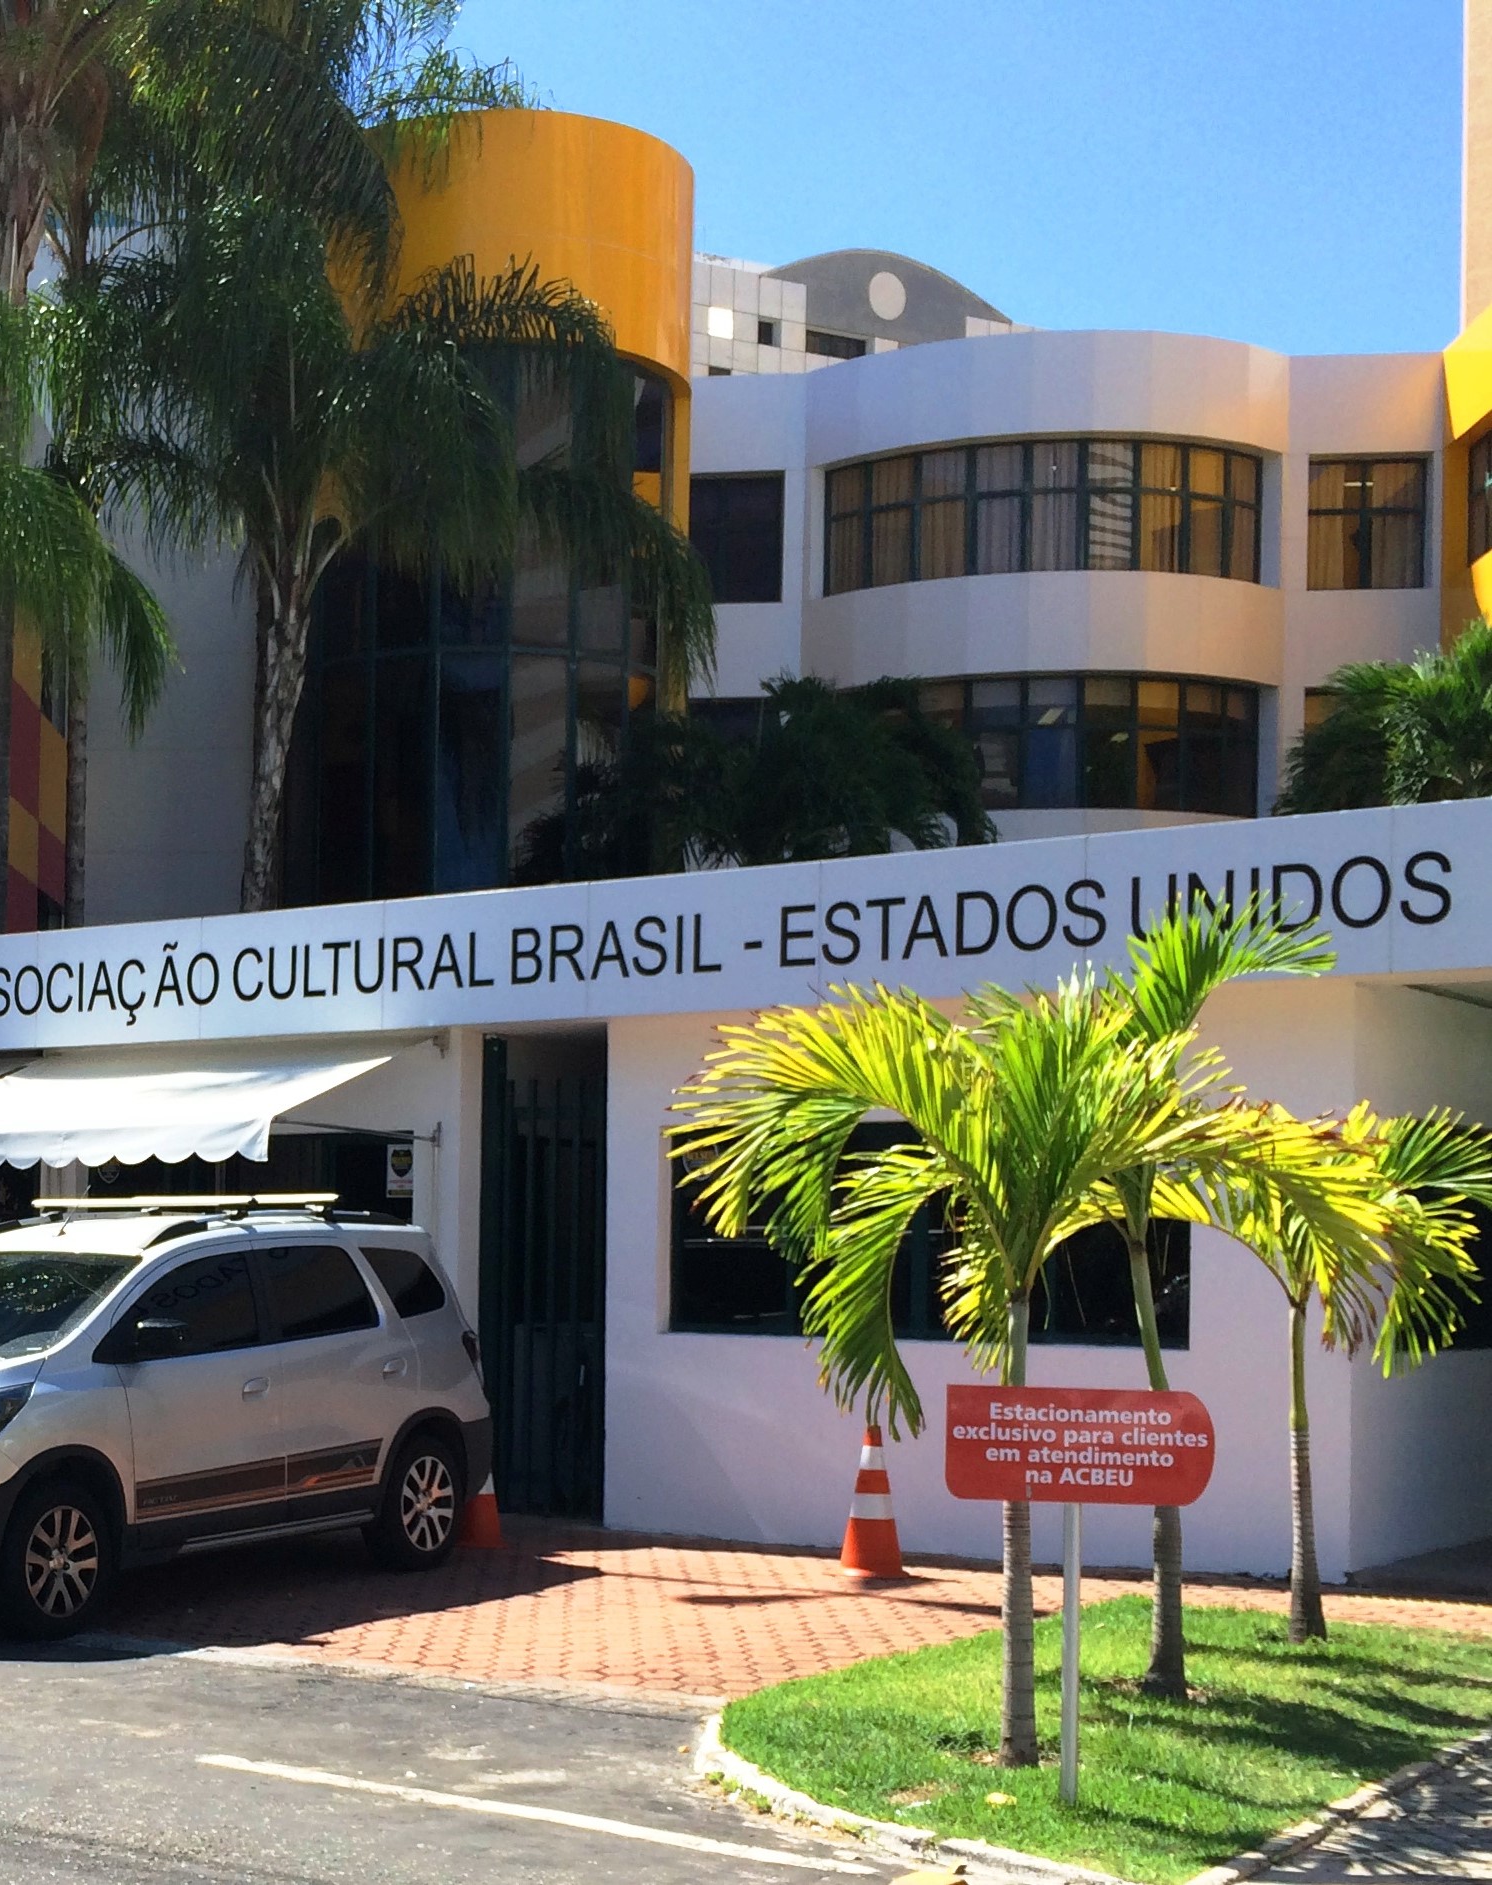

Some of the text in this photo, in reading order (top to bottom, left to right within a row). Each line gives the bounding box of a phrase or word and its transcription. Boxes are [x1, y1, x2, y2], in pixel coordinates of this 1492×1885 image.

[232, 931, 495, 1002] CULTURAL
[511, 913, 722, 985] BRASIL
[779, 878, 1107, 968] ESTADOS
[1131, 851, 1452, 942] UNIDOS
[989, 1402, 1172, 1425] Estacionamento
[952, 1423, 1208, 1448] exclusivo para clientes
[985, 1447, 1174, 1467] em atendimento
[1025, 1468, 1134, 1487] na ACBEU
